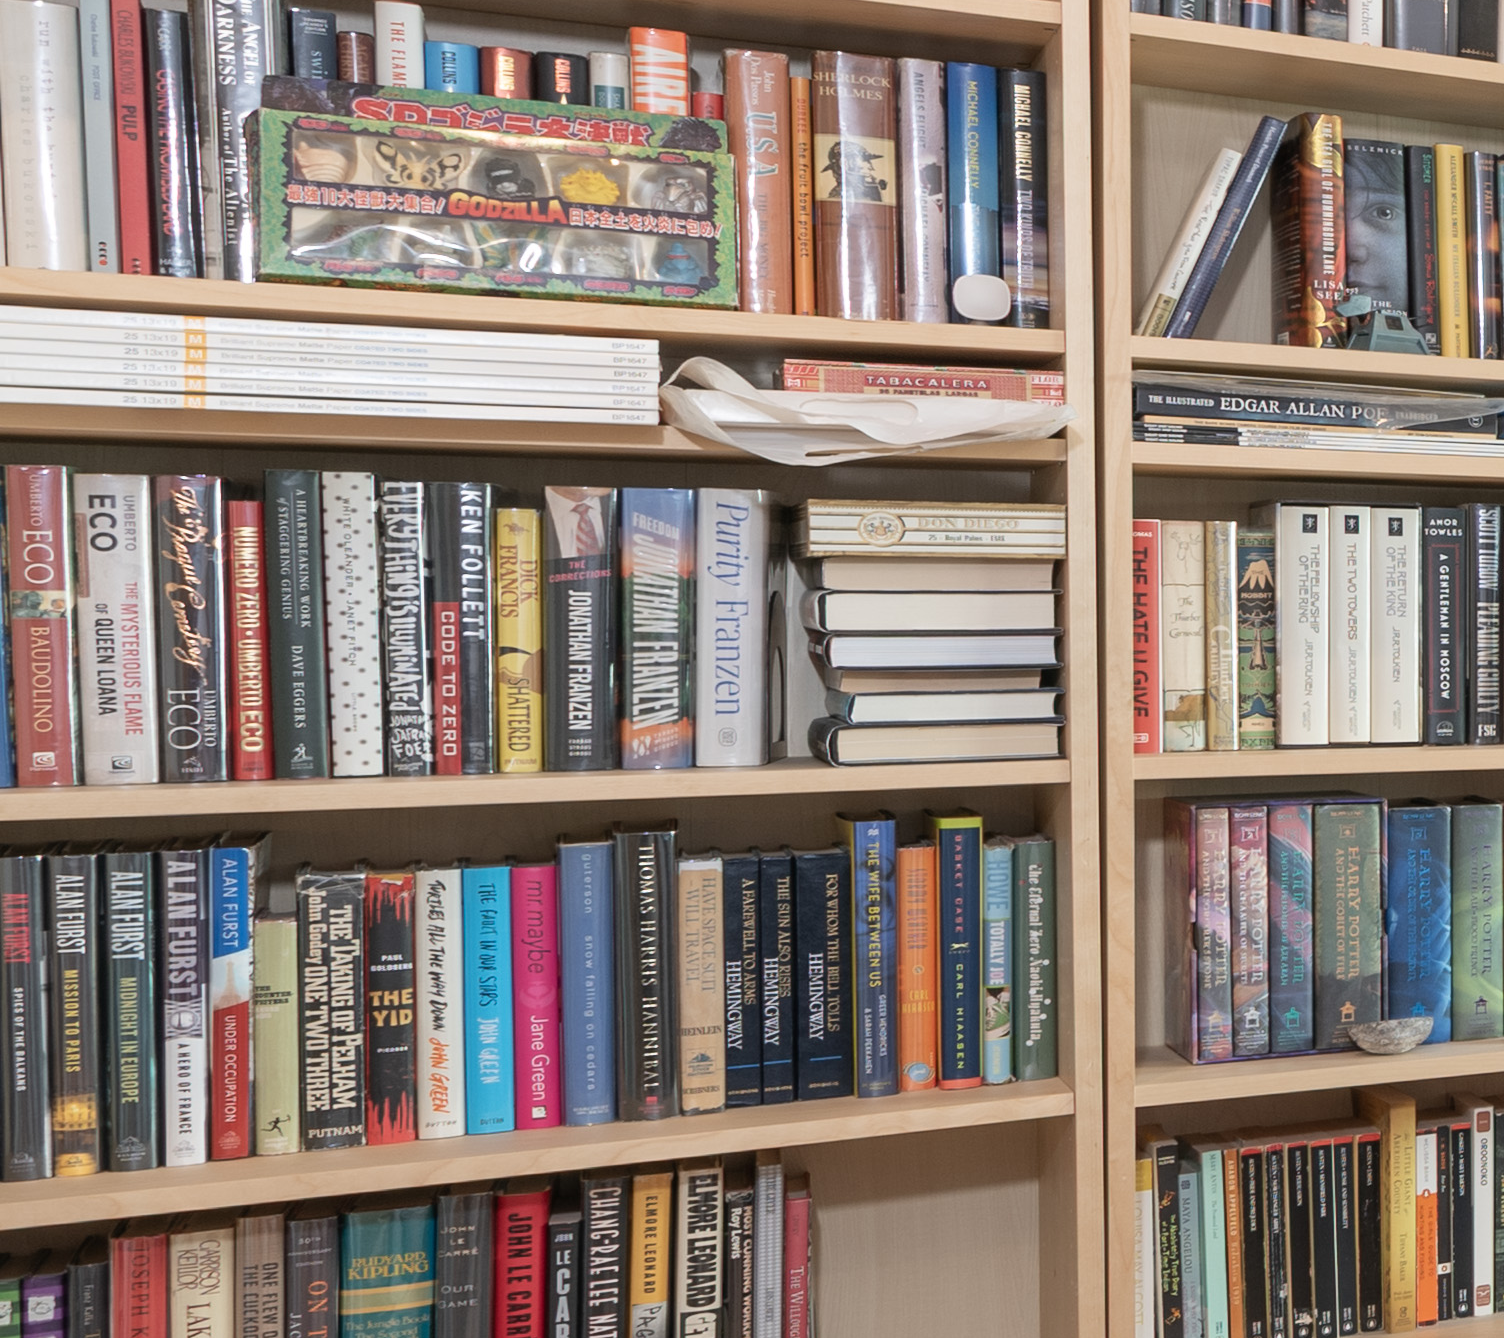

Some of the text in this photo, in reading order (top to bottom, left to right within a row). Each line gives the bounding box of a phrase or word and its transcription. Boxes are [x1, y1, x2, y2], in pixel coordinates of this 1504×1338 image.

[555, 58, 571, 94] COLLINS
[813, 71, 891, 89] SHERLOCK
[818, 85, 883, 101] HOLMES
[448, 192, 568, 225] GODZILLA
[867, 375, 988, 390] TABACALERA
[1220, 397, 1280, 413] EDGAR
[1286, 402, 1344, 419] ALLAN
[87, 494, 118, 553] ECO
[122, 495, 137, 551] UMBERTO
[1425, 528, 1463, 537] TOWLES
[460, 490, 485, 640] KEN FOLLETT
[499, 544, 519, 619] FRANCIS
[519, 560, 538, 603] DICK
[707, 502, 749, 716] Purity Franzen
[1439, 565, 1450, 629] GENTLEMAN
[94, 603, 117, 716] OF QUEEN LOANA
[120, 581, 144, 736] THE MYSTERIOUS FLAME
[1440, 634, 1449, 645] IN
[29, 626, 53, 733] BAUDOLINO
[441, 611, 458, 756] CODE TO ZERO
[1440, 649, 1450, 700] MOSCOW
[506, 678, 531, 752] SHATTERED
[369, 989, 413, 1006] THE
[373, 1010, 413, 1028] YID
[808, 952, 824, 1041] HEMINGWAY
[307, 1281, 328, 1313] ON
